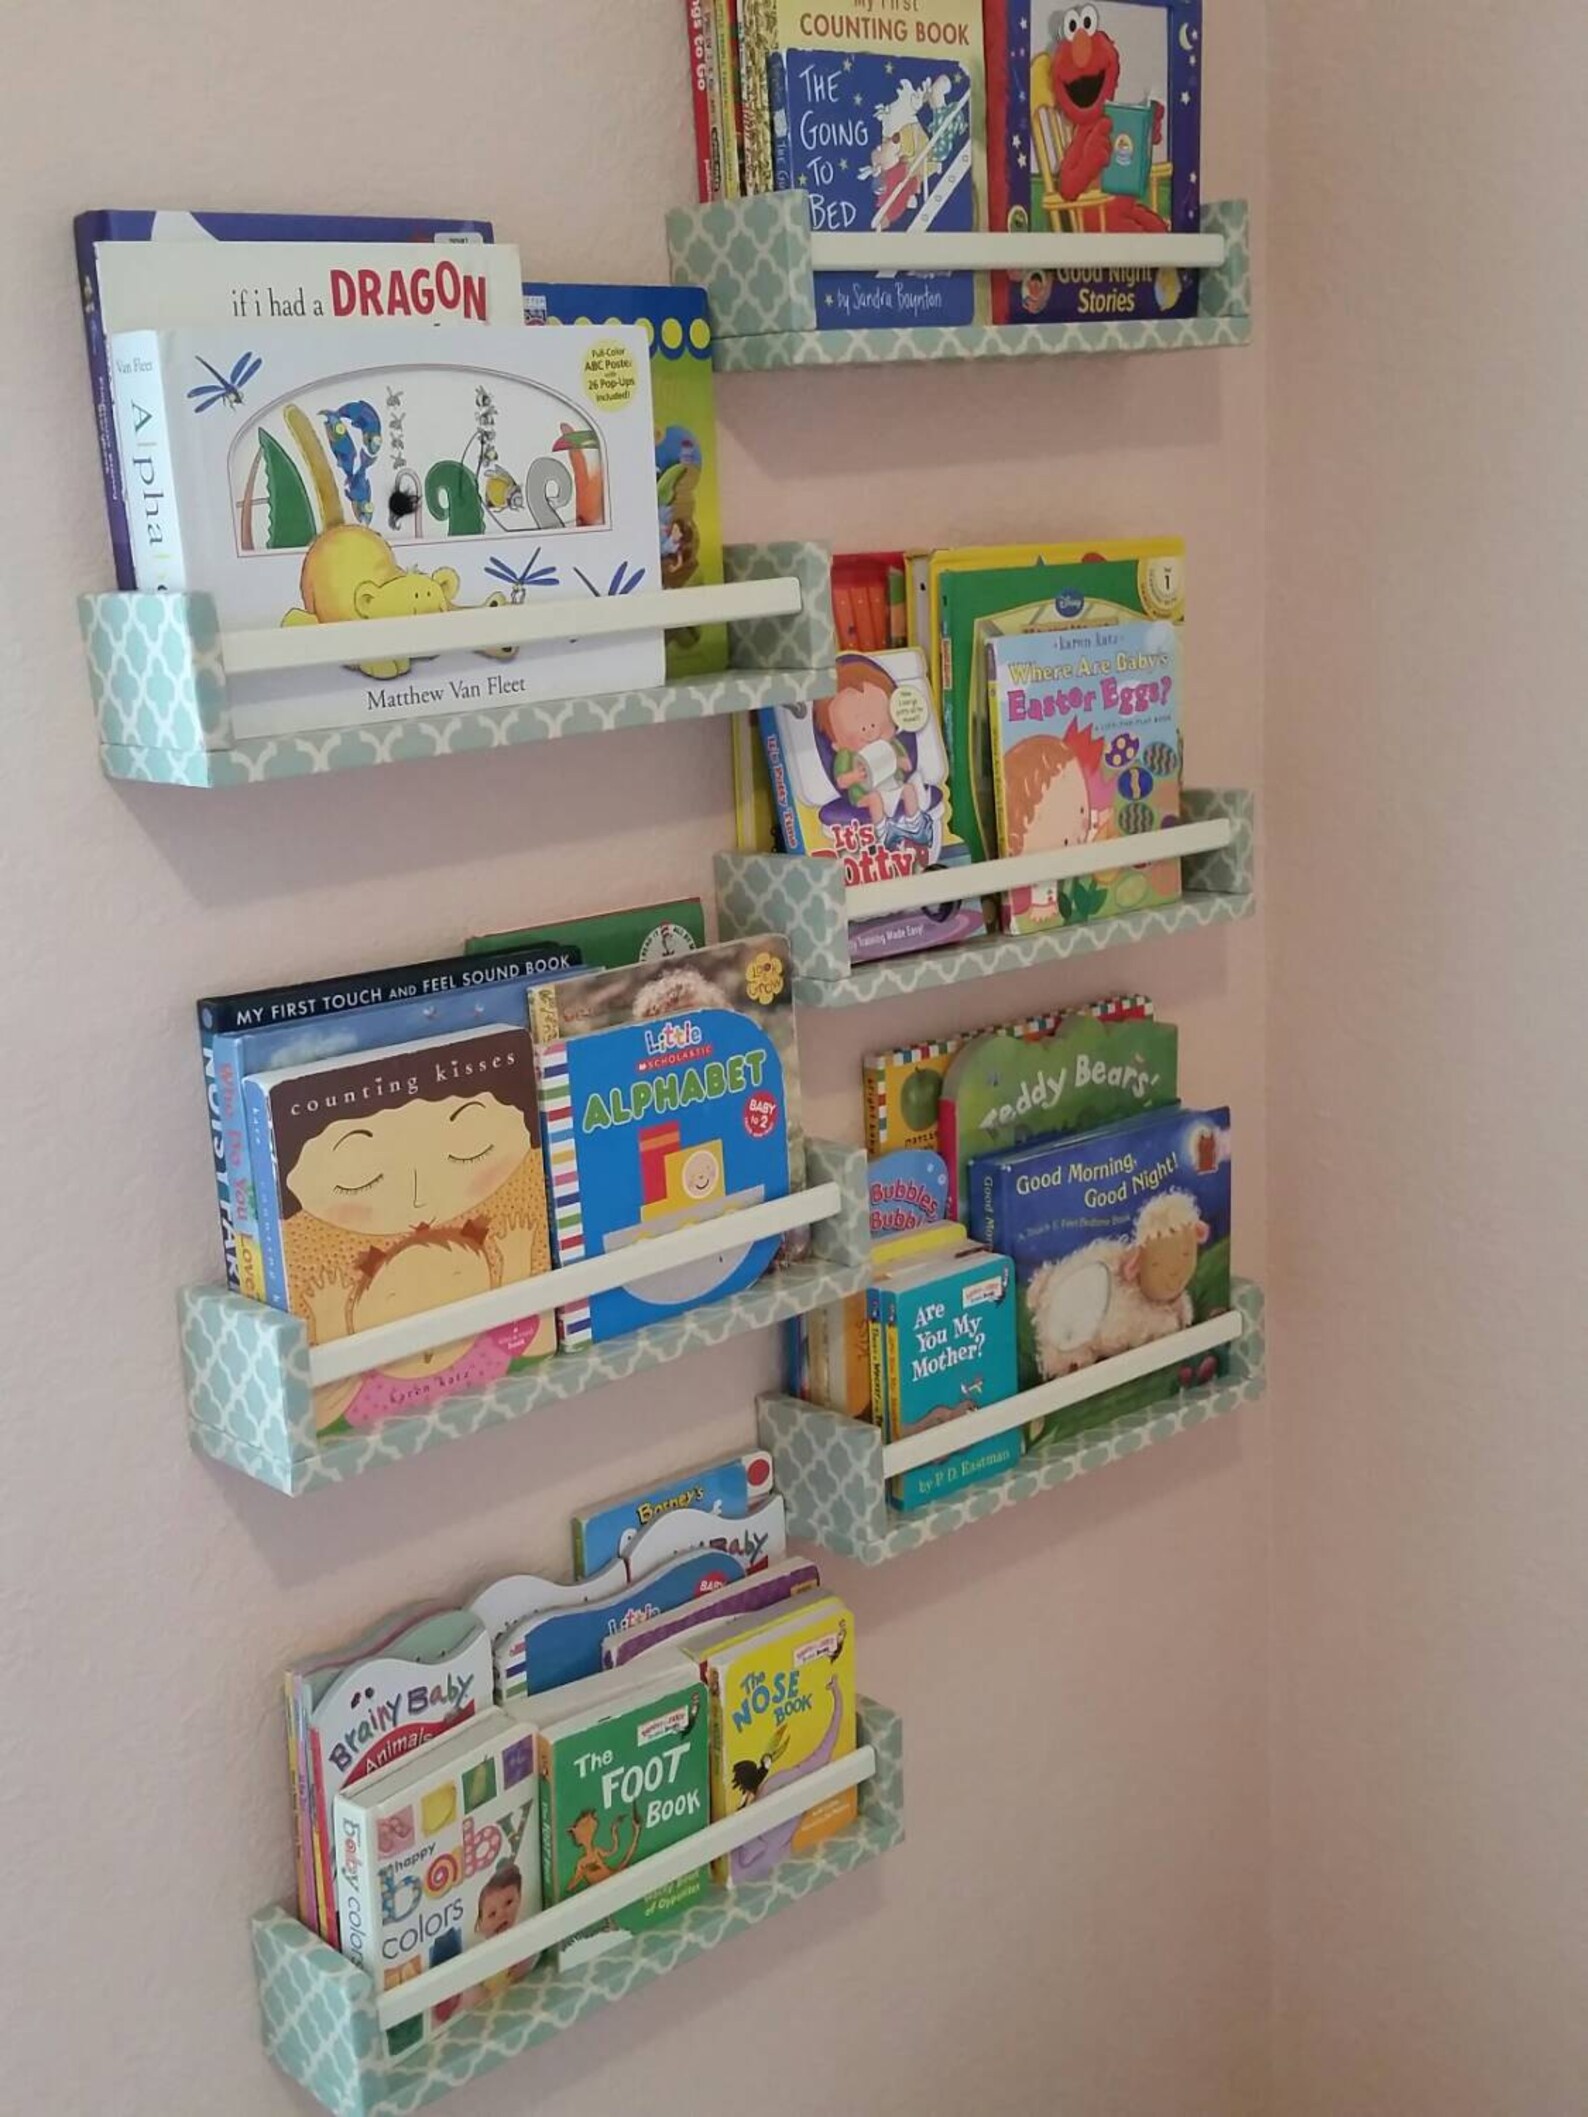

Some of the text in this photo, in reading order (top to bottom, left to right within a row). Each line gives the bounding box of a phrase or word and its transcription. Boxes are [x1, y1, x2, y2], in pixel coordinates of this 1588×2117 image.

[694, 34, 705, 58] to
[800, 13, 970, 46] COUNTING BOOK
[696, 63, 706, 91] Go
[799, 64, 842, 103] THE
[801, 111, 868, 150] GOING
[807, 156, 834, 187] TO
[809, 193, 856, 230] BED
[231, 260, 487, 322] if i had a DRAGON
[837, 281, 943, 317] by Sandra Boynton
[1077, 287, 1136, 314] Stories
[116, 361, 131, 375] Van
[584, 361, 604, 371] ABC
[588, 379, 599, 390] 26
[1008, 661, 1072, 685] Where
[1079, 655, 1111, 678] Are
[367, 675, 527, 711] Matthew Van Fleet
[1008, 675, 1172, 722] Easter Eggs?
[831, 820, 875, 851] It's
[812, 845, 914, 887] otty
[237, 955, 571, 1026] MY FIRST TOUCH AND FEEL SOUND BOOK
[645, 1020, 702, 1055] Little
[649, 1046, 713, 1070] SCHOLASTIC
[291, 1051, 515, 1115] counting kisses
[582, 1049, 767, 1134] ALPHABET
[978, 1067, 1067, 1131] Teddy
[749, 1099, 776, 1115] BABY
[751, 1115, 759, 1125] to
[760, 1114, 768, 1128] 2
[1016, 1166, 1062, 1195] Good
[1084, 1151, 1179, 1209] Good Night!
[232, 1177, 250, 1221] You
[870, 1207, 925, 1231] Bubbl
[913, 1300, 946, 1331] Are
[916, 1312, 983, 1353] You My
[911, 1332, 986, 1382] Mother?
[918, 1479, 933, 1494] by
[961, 1449, 1010, 1477] Eastman
[741, 1671, 767, 1694] The
[732, 1670, 800, 1733] NOSE
[774, 1693, 812, 1727] BOOK
[329, 1673, 474, 1772] Brainy Baby
[365, 1727, 436, 1775] Animals
[574, 1750, 614, 1779] The
[601, 1741, 691, 1810] FOOT
[646, 1788, 700, 1829] BOOK
[341, 1817, 362, 1893] baby
[379, 1799, 533, 1926] baby
[394, 1842, 437, 1871] happy
[382, 1898, 464, 1960] colors
